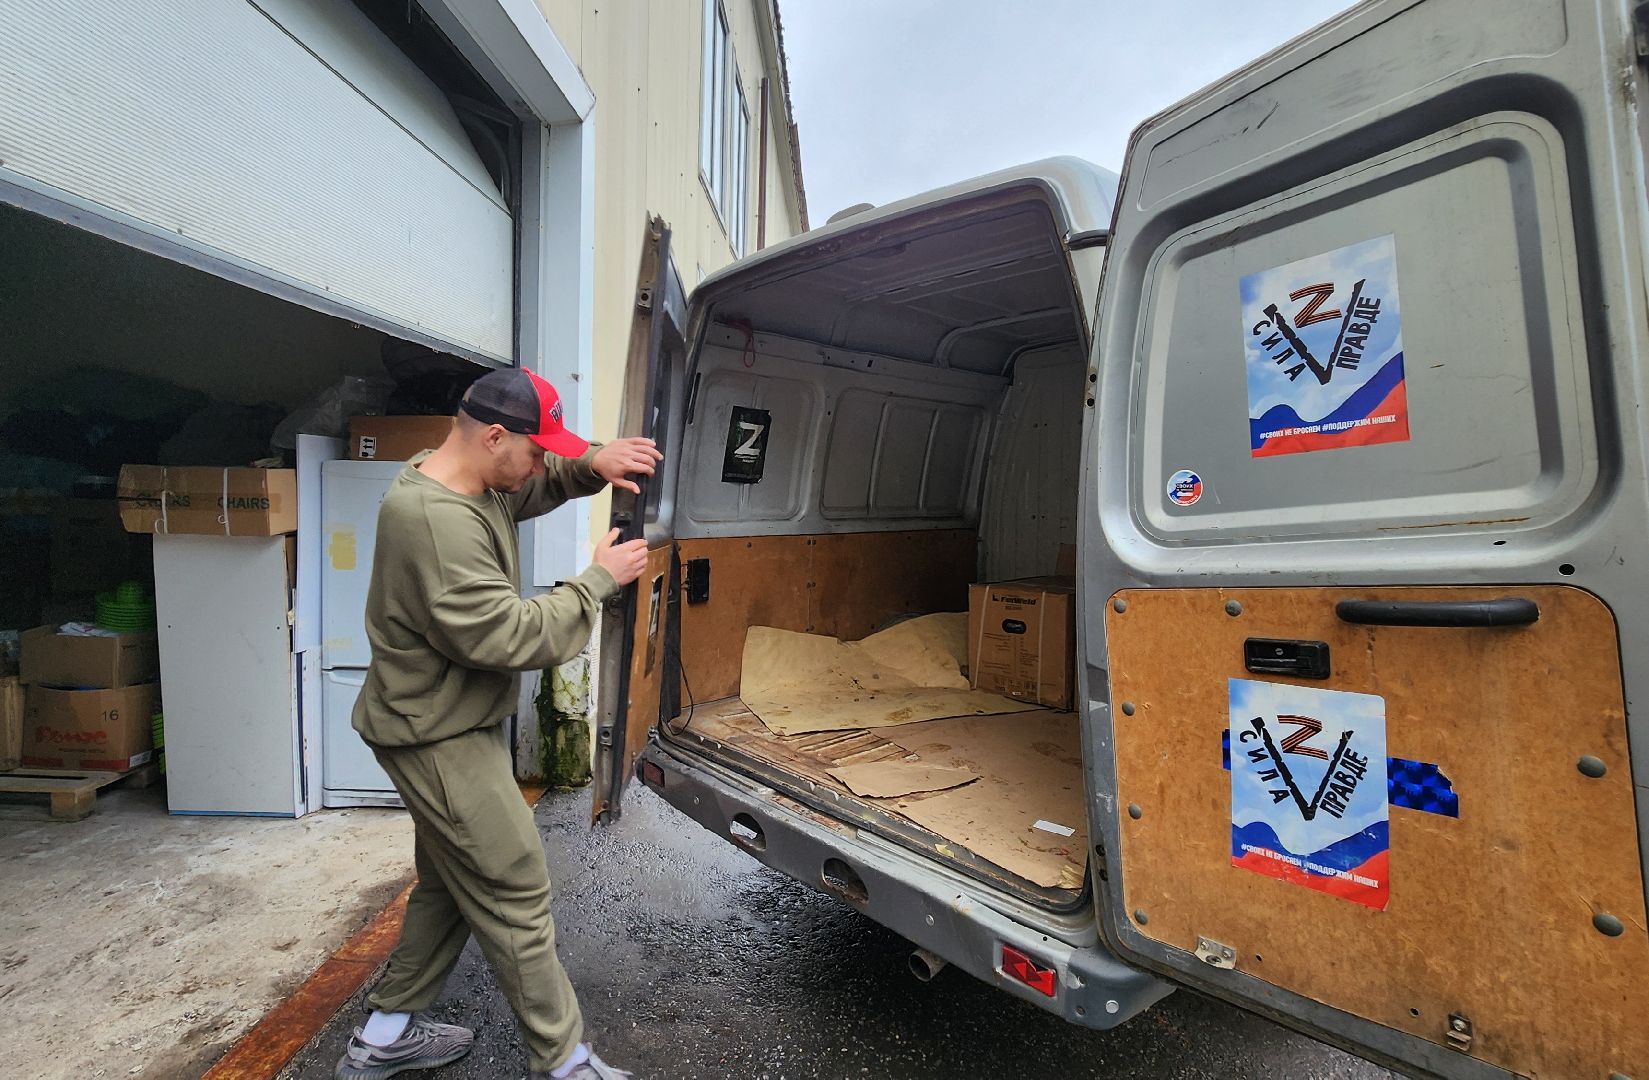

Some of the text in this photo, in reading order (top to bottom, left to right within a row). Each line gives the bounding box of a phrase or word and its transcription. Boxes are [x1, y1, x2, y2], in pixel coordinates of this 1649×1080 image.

[1252, 319, 1308, 382] СИЛА
[1336, 296, 1382, 371] ПРАВДЕ
[734, 422, 765, 455] Z
[1259, 429, 1284, 439] #СВОИХ
[1293, 425, 1321, 435] БРОСАЕМ
[1322, 419, 1371, 432] #ПОДДЕРЖИМ
[1371, 414, 1397, 425] НАШИХ
[217, 496, 270, 510] CHAIRS
[101, 709, 119, 722] 16
[1239, 729, 1291, 806] СИЛА
[1319, 747, 1369, 819] ПРАВДЕ
